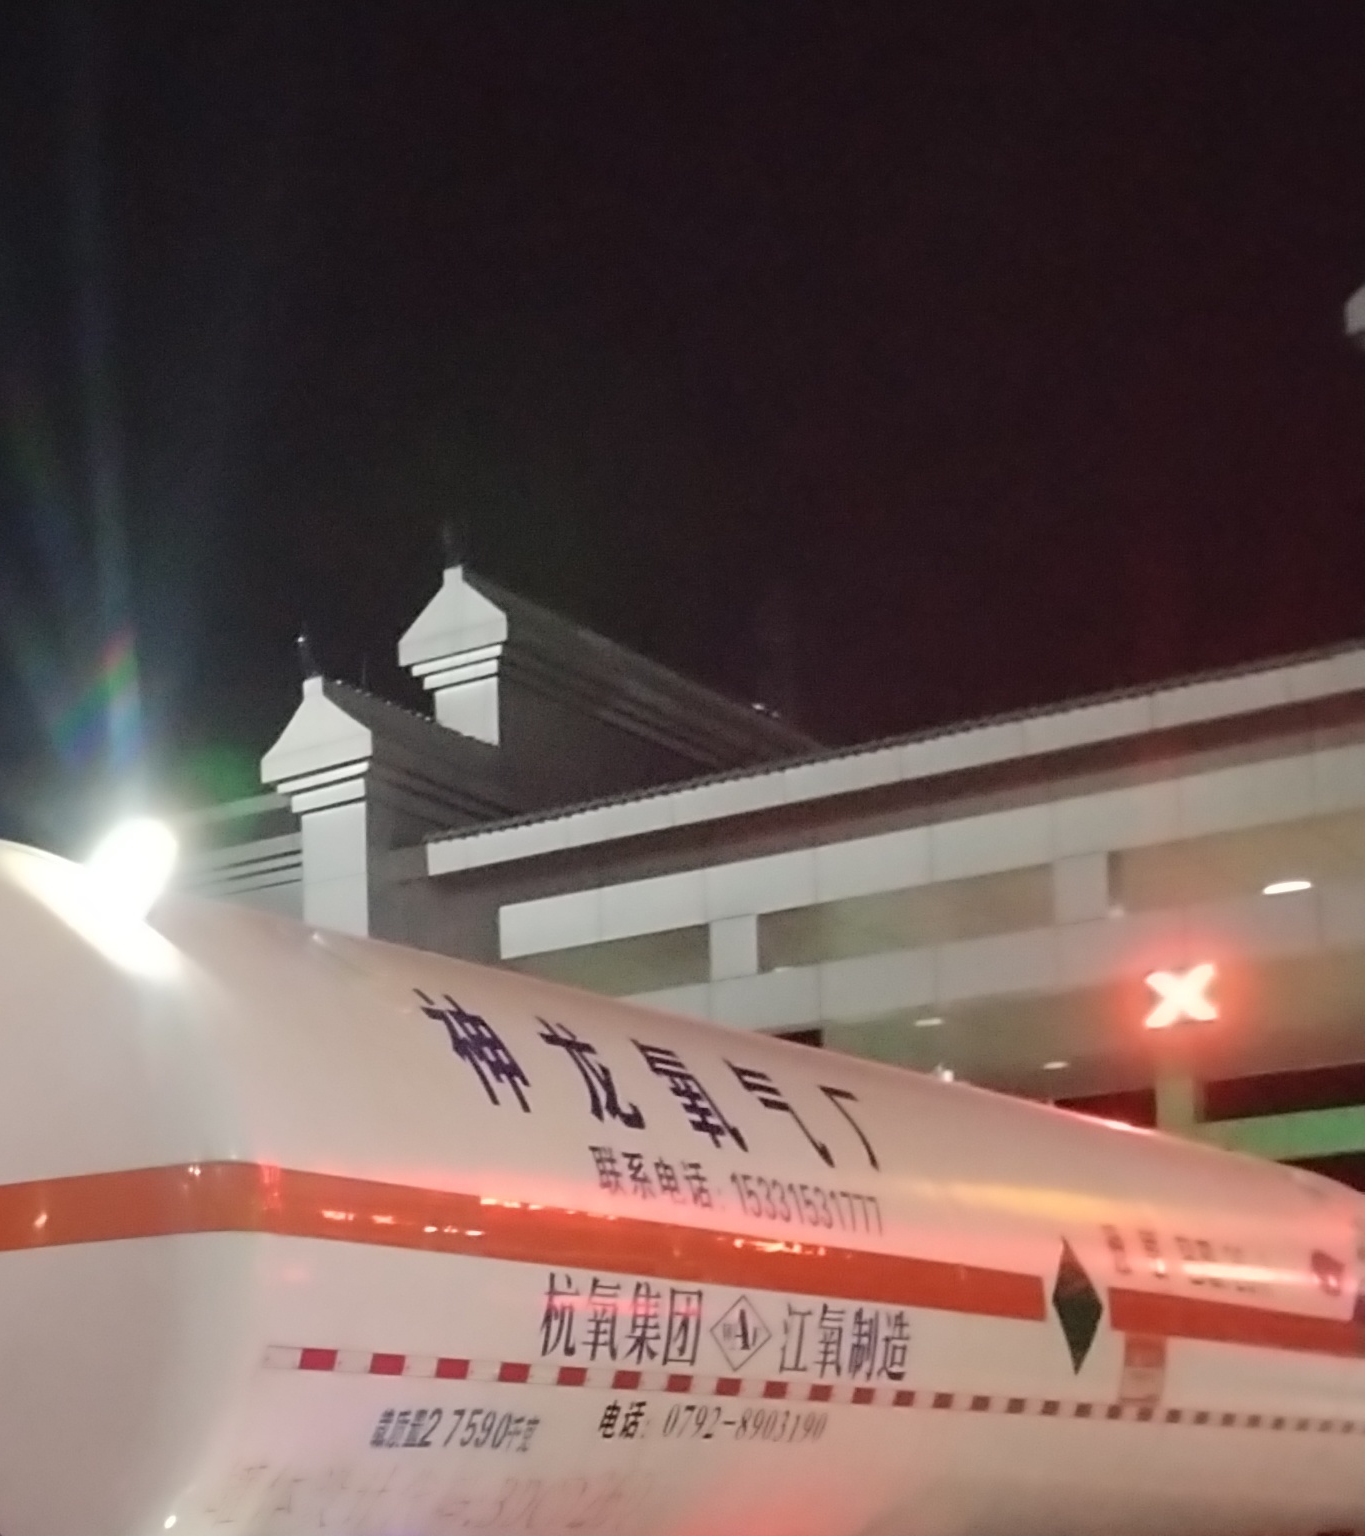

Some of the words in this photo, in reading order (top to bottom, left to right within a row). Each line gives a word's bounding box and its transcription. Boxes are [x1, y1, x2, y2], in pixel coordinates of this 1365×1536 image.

[412, 988, 879, 1170] 神龙氧气厂
[540, 1272, 704, 1368] 杭氧集团
[777, 1302, 911, 1383] 江氧制造
